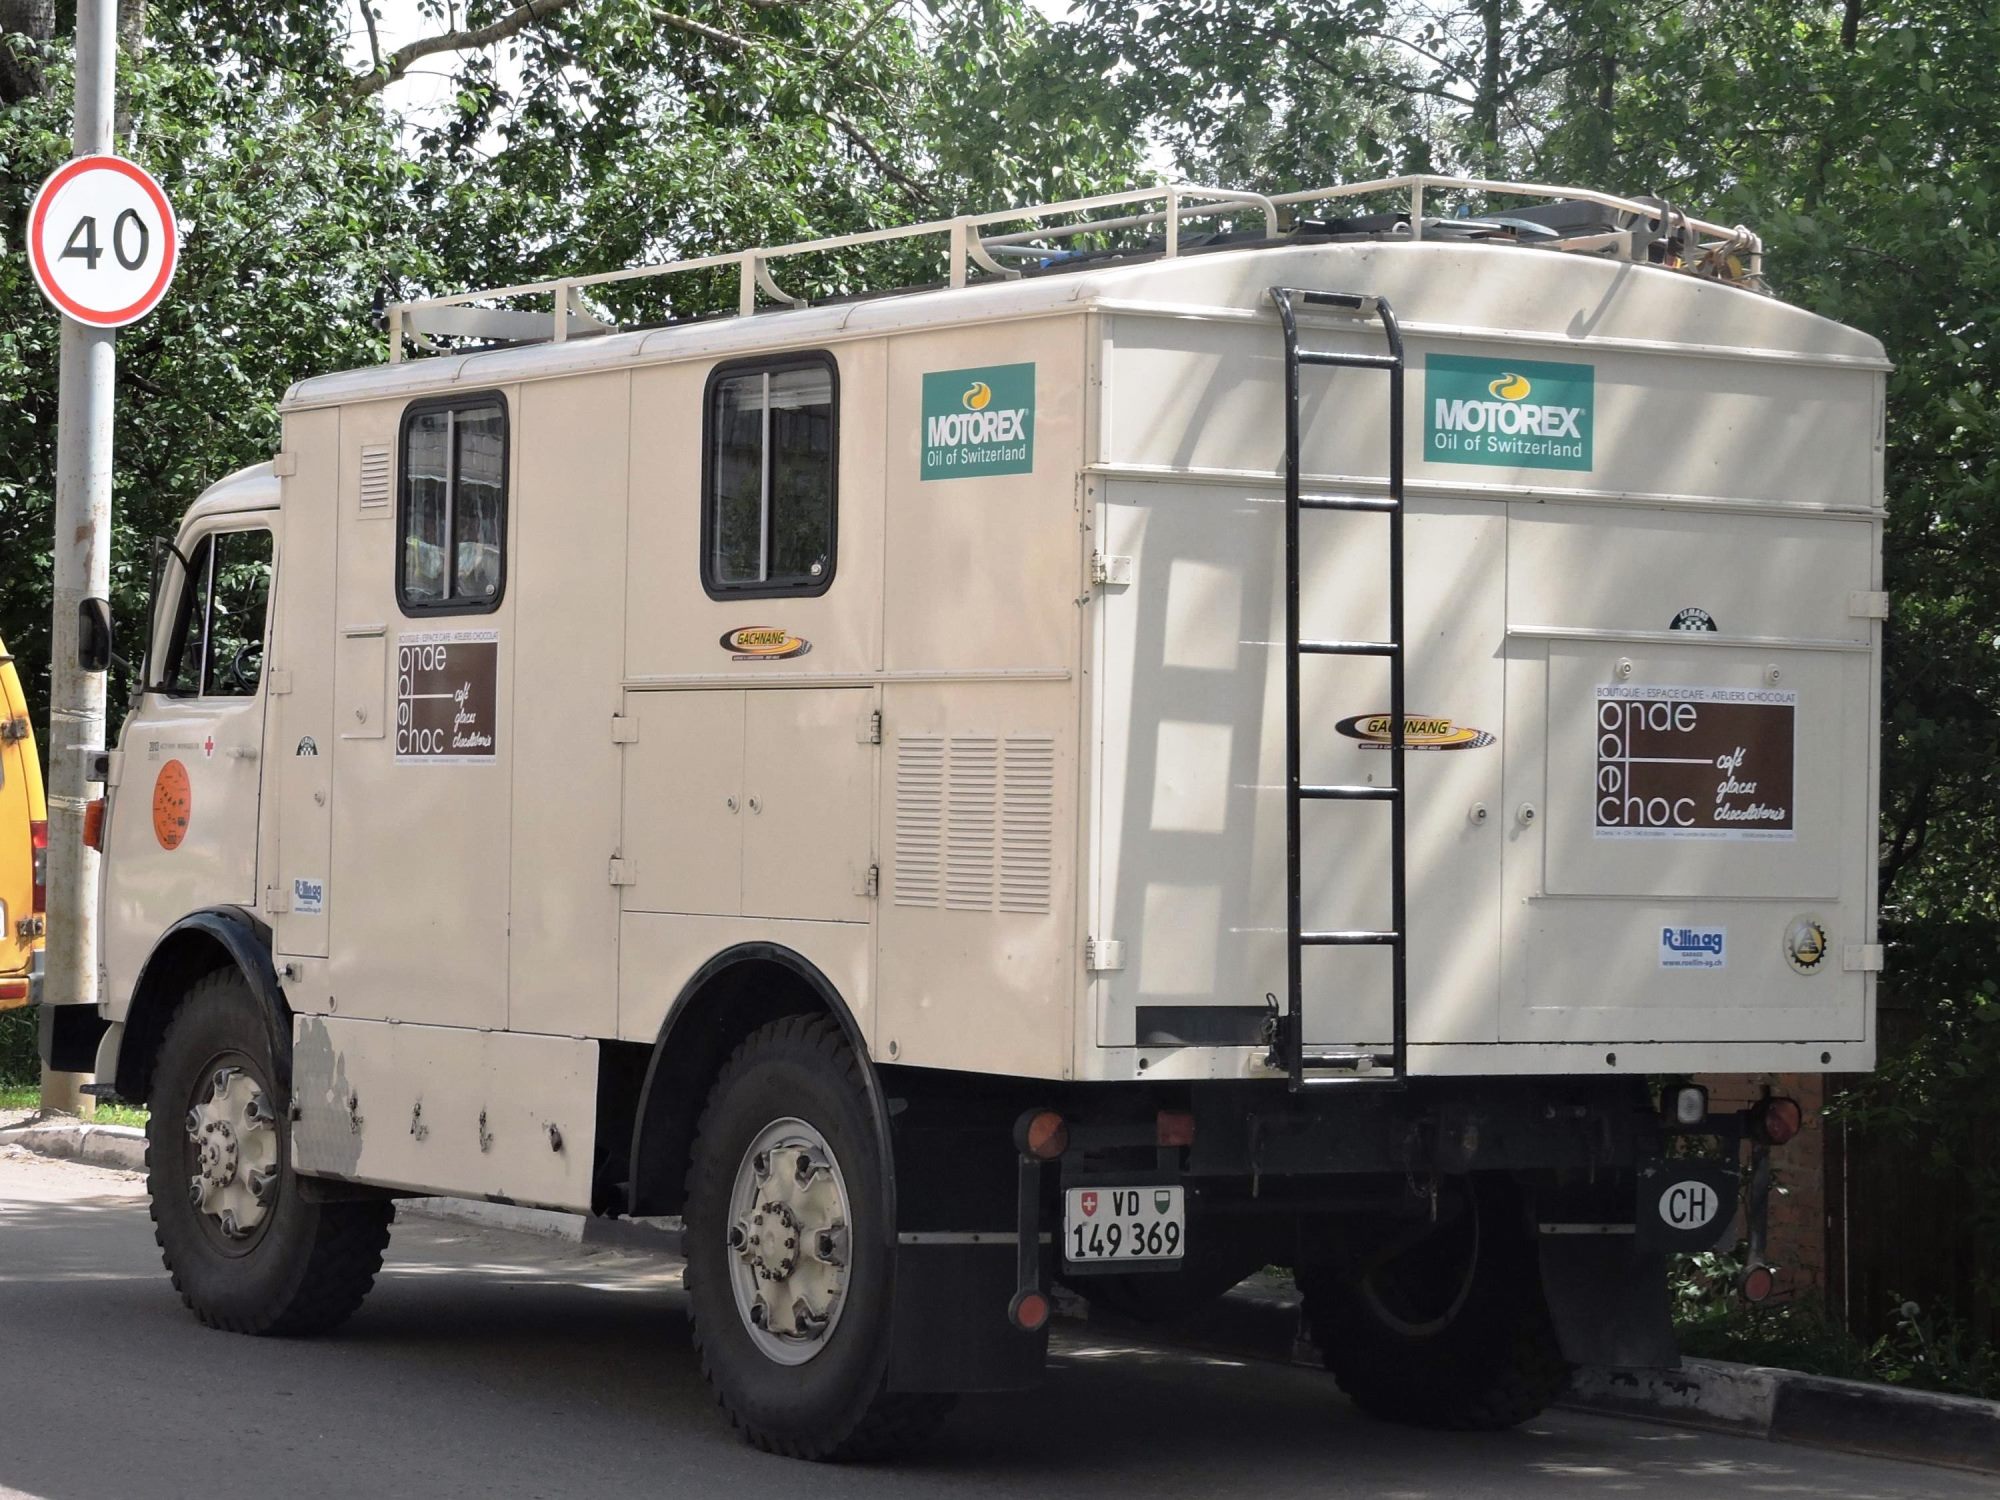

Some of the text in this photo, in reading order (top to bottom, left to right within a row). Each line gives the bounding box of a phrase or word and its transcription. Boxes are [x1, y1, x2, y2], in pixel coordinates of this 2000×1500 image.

[58, 207, 150, 271] 40
[927, 408, 1026, 448] MOTOREX
[1435, 398, 1581, 439] MOTOREX
[927, 443, 1026, 467] Oil of Switzerland
[1434, 432, 1582, 458] Oil of Switzerland
[736, 631, 785, 645] GACHNANG
[399, 643, 447, 672] onde
[1597, 687, 1640, 698] BOUTIQUE
[1647, 688, 1680, 699] ESPACE
[1681, 689, 1704, 700] CAFE
[1711, 691, 1745, 701] ATELIERS
[1747, 692, 1796, 703] CHOCOLAT
[1367, 719, 1449, 734] GANANG
[1599, 700, 1697, 732] onde
[397, 728, 444, 754] choc
[1716, 745, 1747, 777] café
[1715, 775, 1758, 804] glaces
[1598, 796, 1696, 826] choc
[1713, 802, 1786, 821] chocolaterie
[1112, 1190, 1140, 1217] VD
[1669, 1187, 1706, 1224] CH
[1073, 1221, 1180, 1258] 149 369
